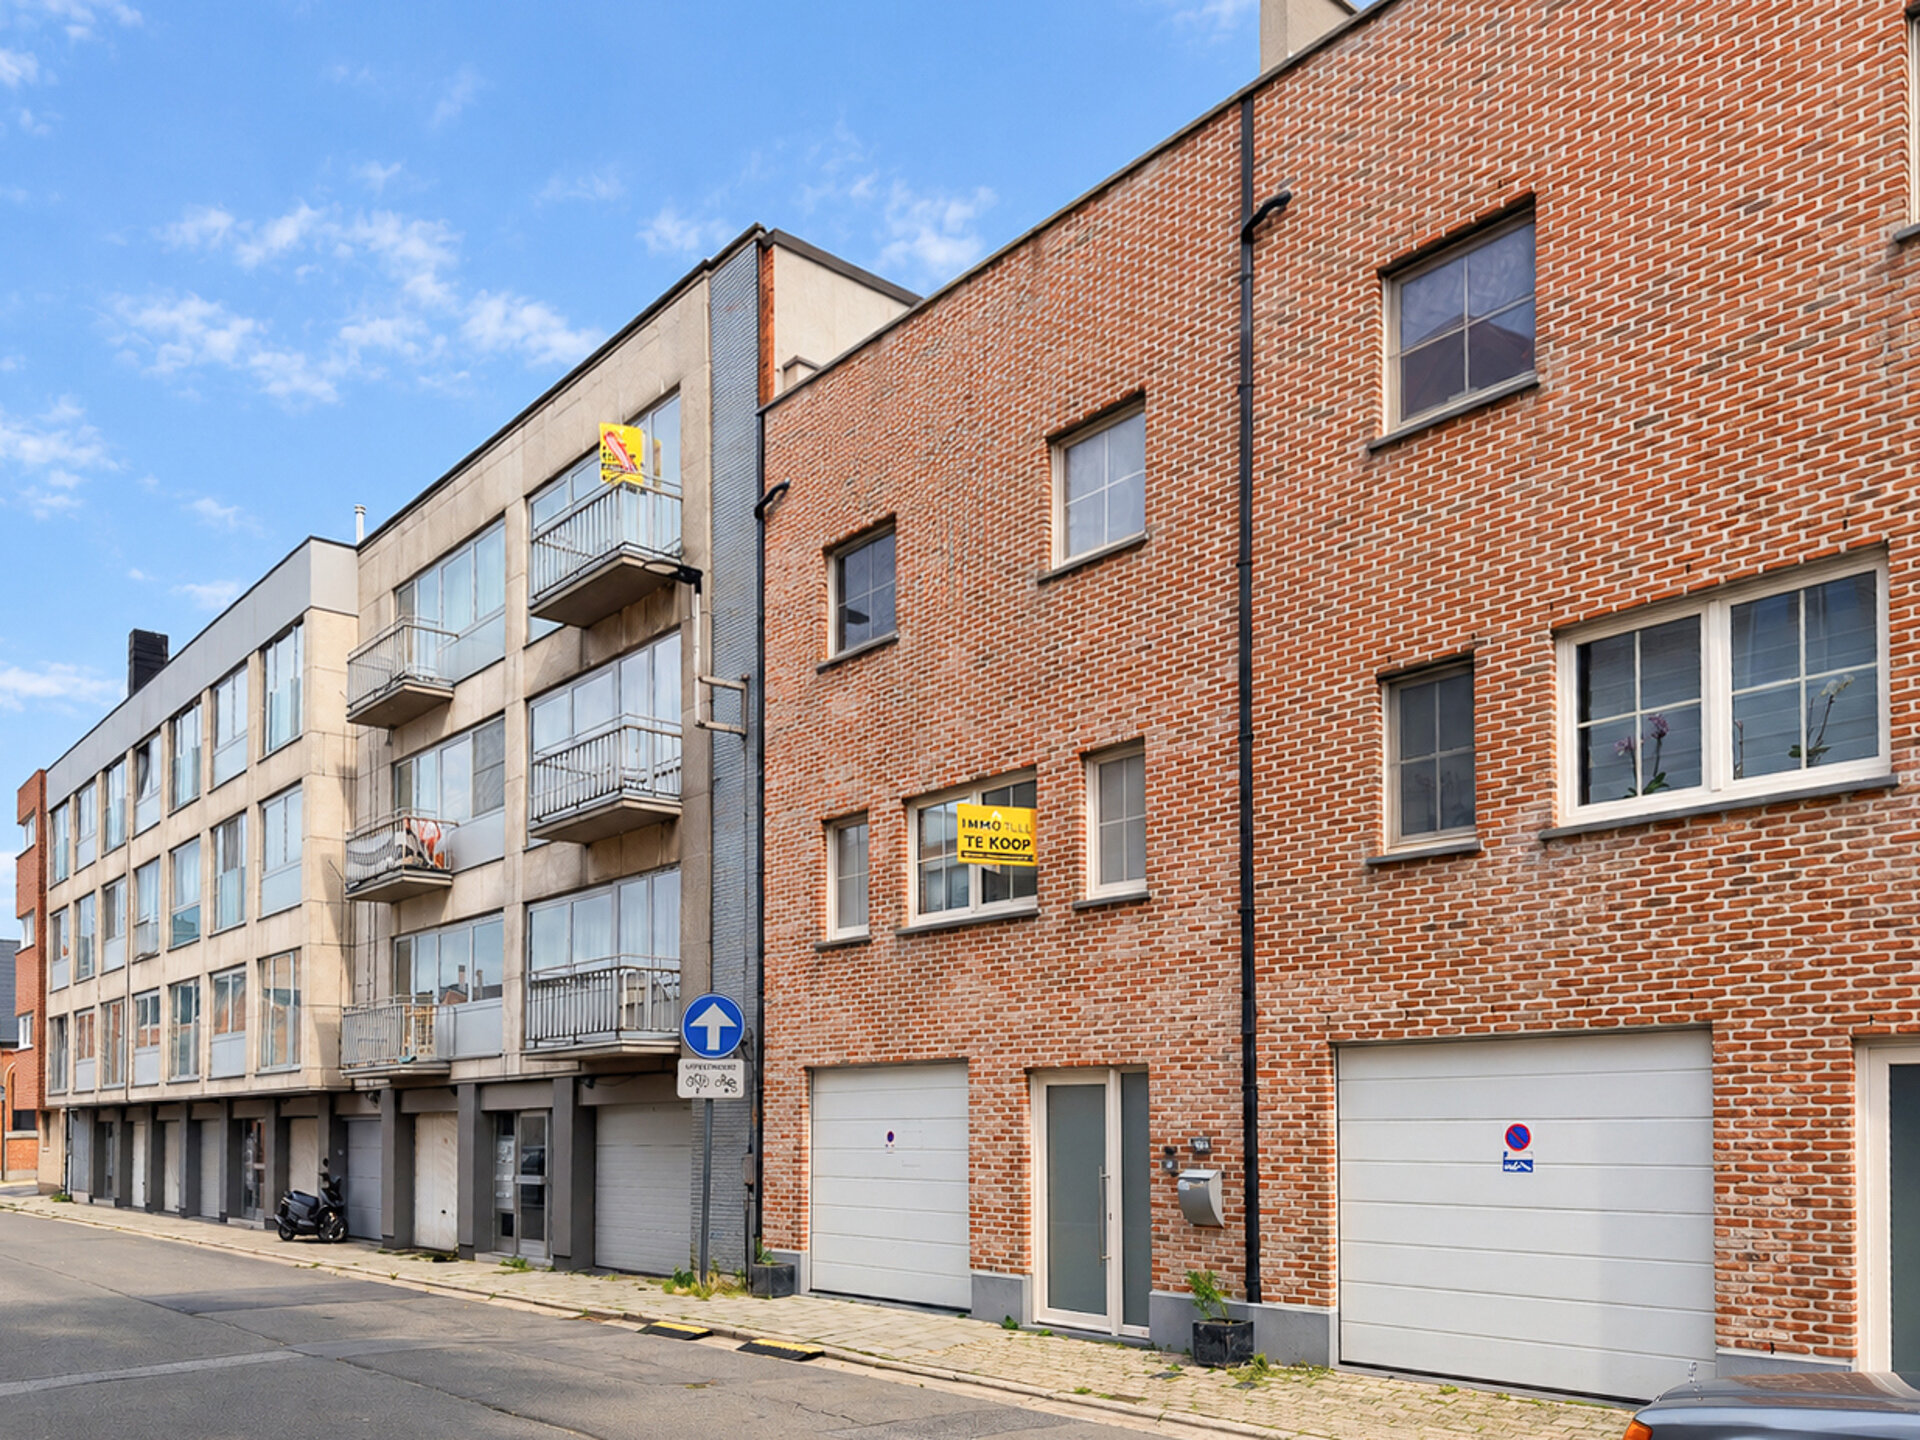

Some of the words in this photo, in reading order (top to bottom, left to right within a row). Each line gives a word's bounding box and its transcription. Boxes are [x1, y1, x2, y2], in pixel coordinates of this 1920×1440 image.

[962, 818, 1001, 831] IMMO
[964, 835, 983, 848] TE
[989, 837, 1031, 850] KOOP
